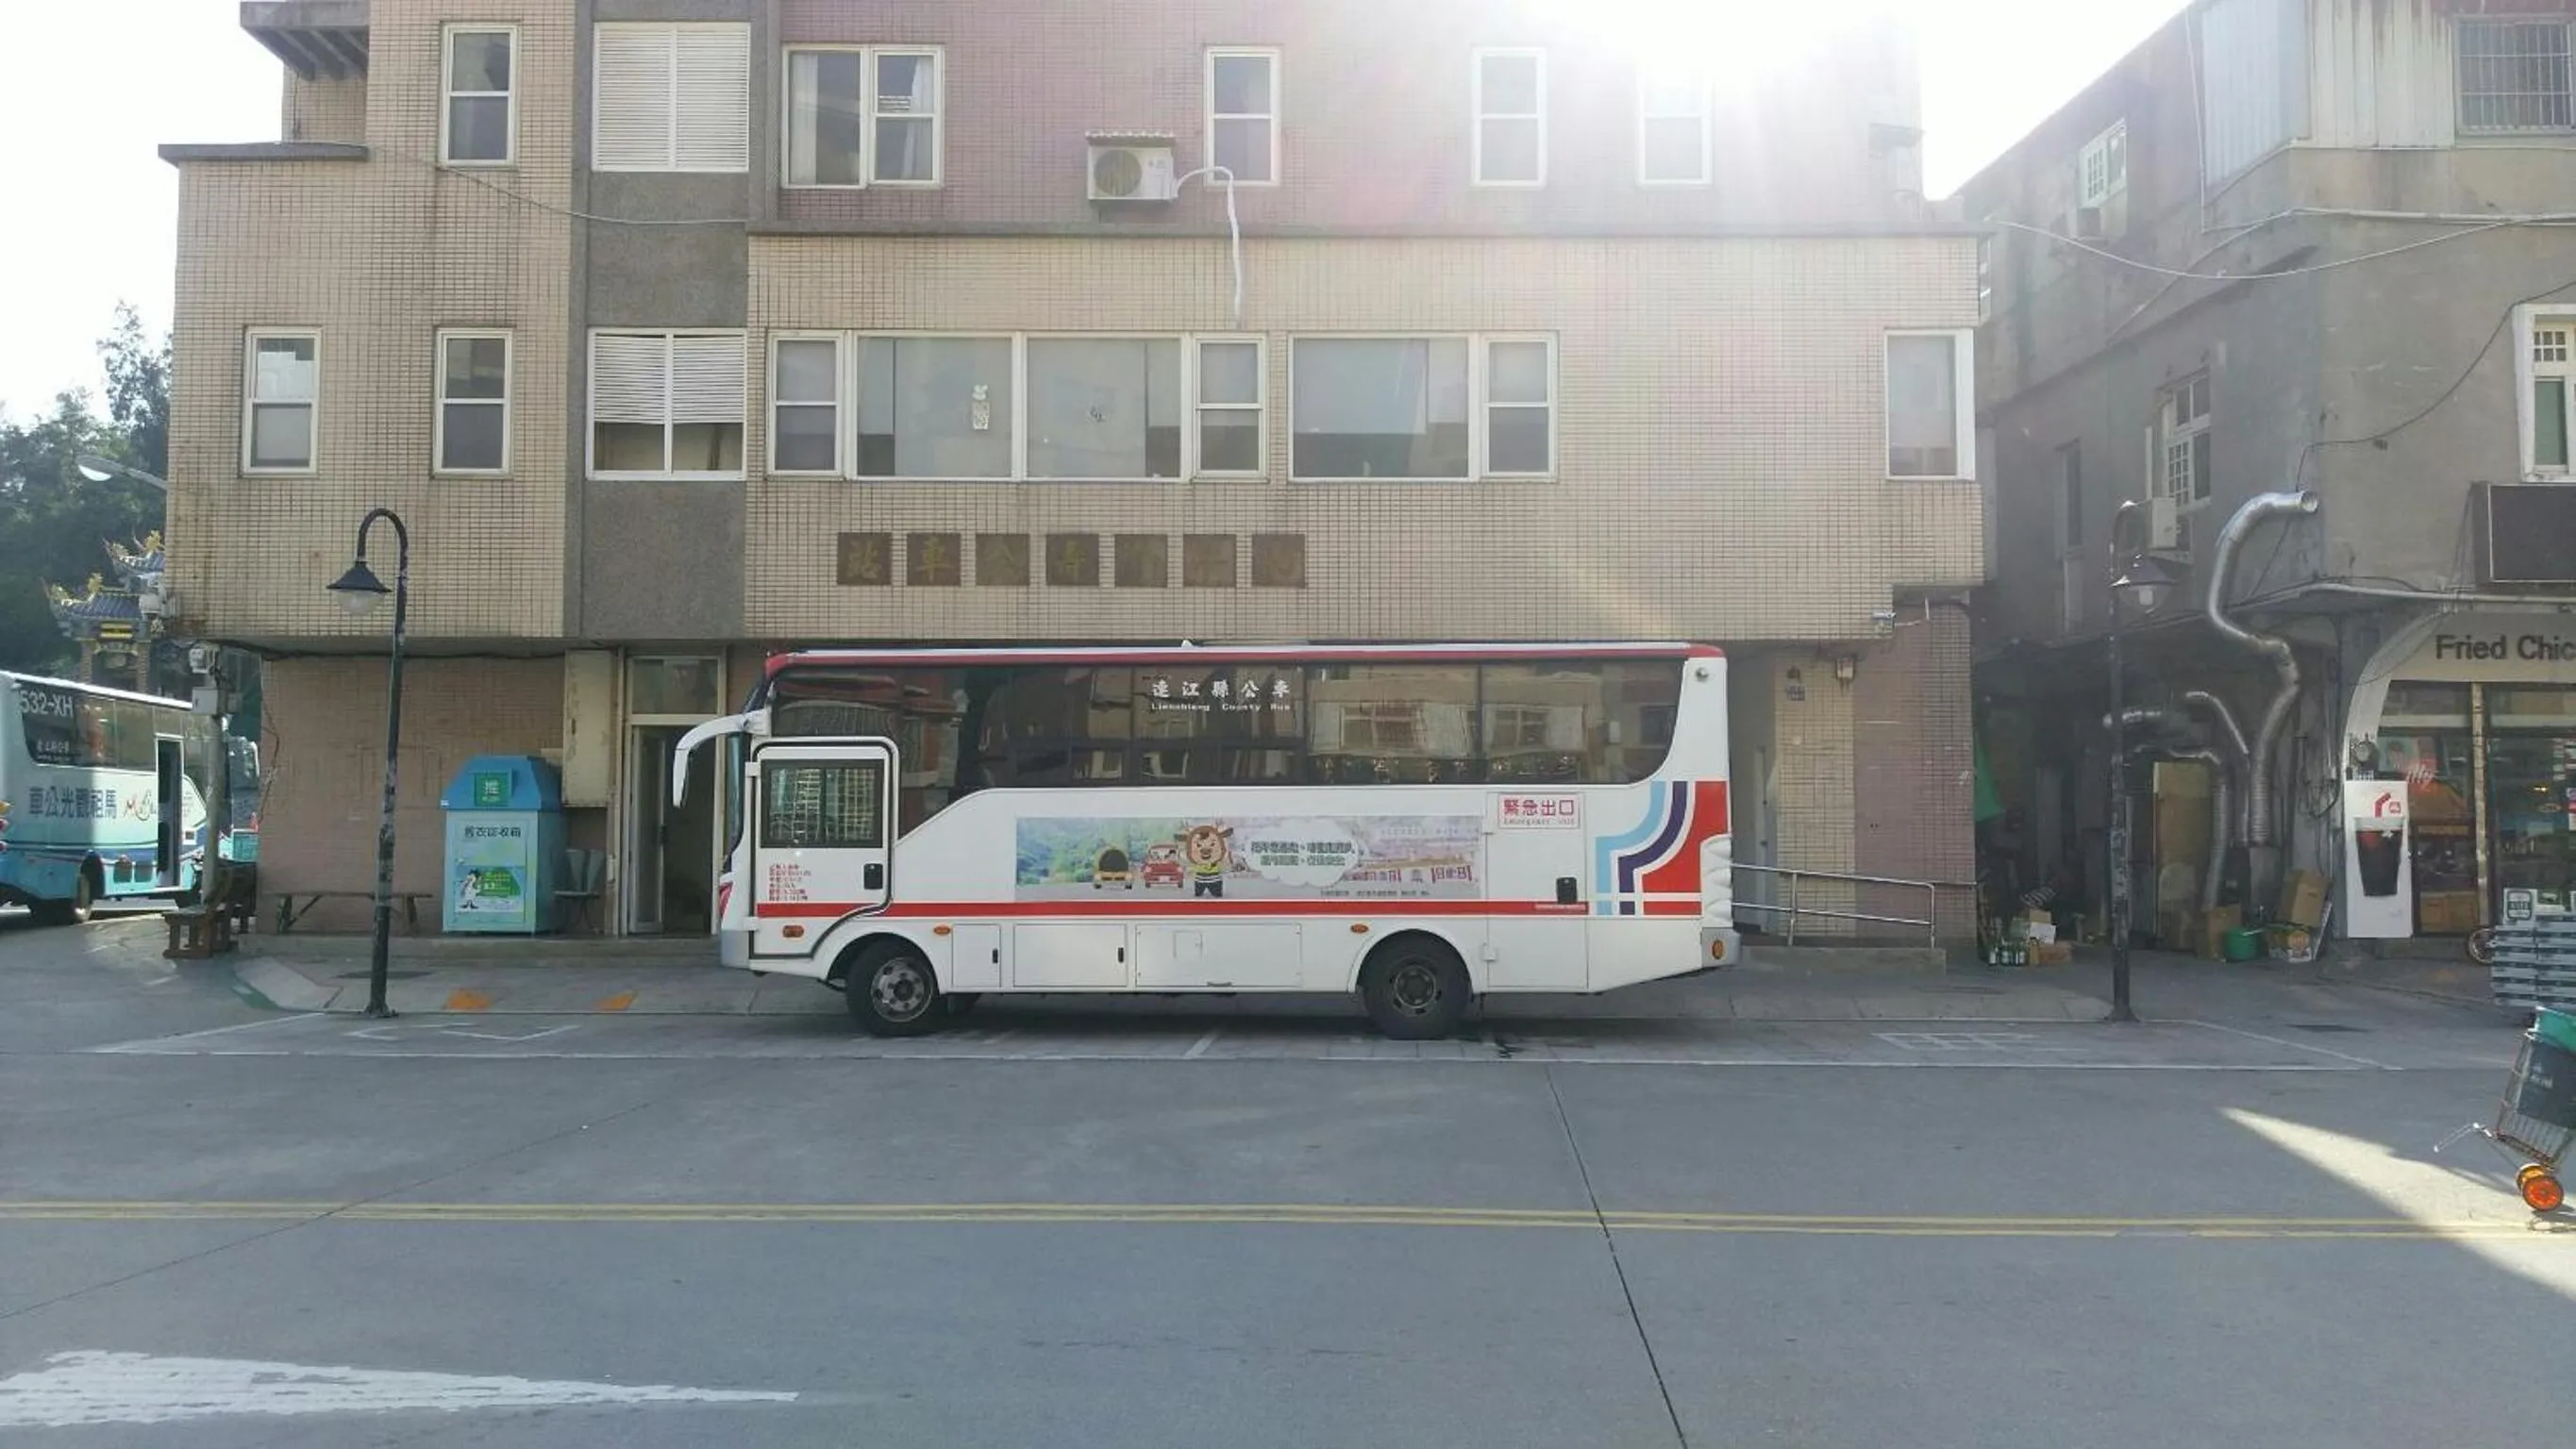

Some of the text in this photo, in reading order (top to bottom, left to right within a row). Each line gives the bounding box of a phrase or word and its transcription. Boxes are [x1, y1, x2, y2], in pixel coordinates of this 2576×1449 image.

[2435, 635, 2506, 660] Fried
[1152, 678, 1291, 698] 連江縣公車
[19, 690, 74, 717] 532-XH
[1503, 799, 1575, 816] 緊急出口
